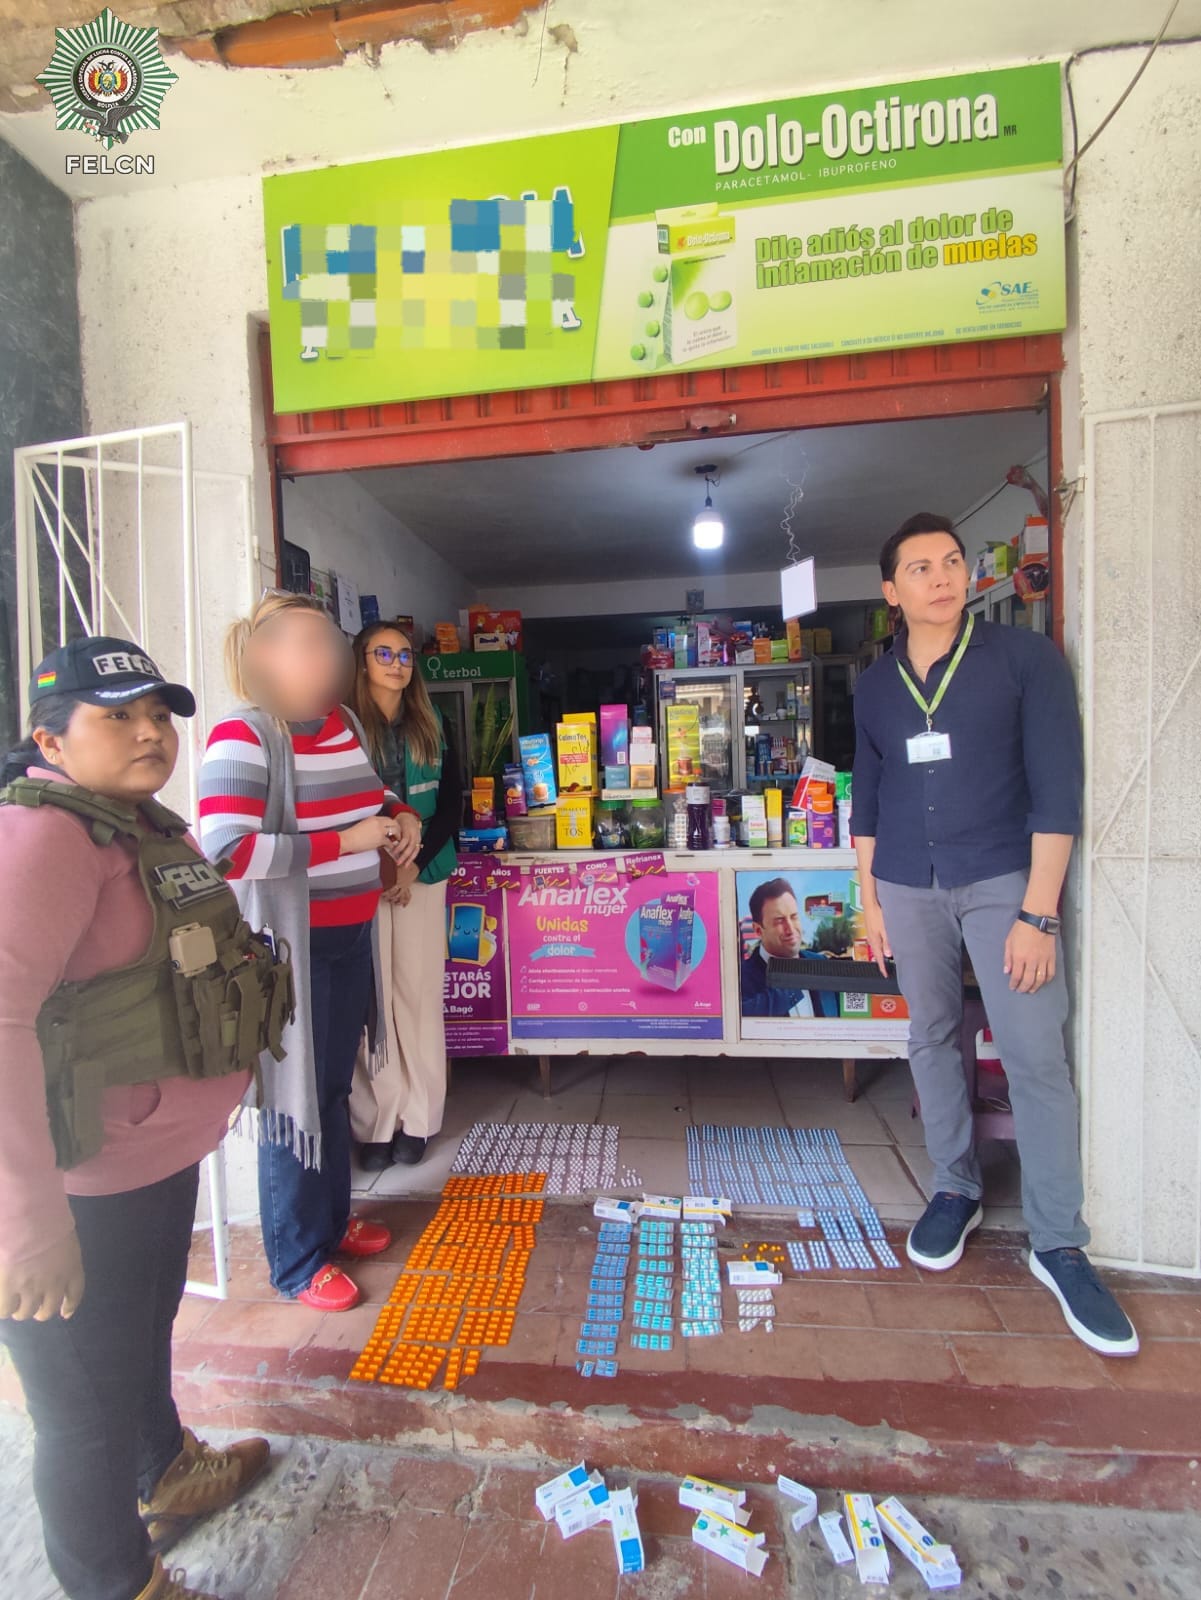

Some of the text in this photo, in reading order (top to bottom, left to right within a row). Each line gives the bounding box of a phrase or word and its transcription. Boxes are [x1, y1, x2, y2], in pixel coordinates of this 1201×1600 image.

[668, 93, 1017, 175] Con Dolo-Octirona MR
[819, 158, 897, 178] IBUPROFENO
[755, 207, 1013, 262] Dile adiós al dolor de
[756, 232, 1038, 289] Inflamación de muelas
[1000, 281, 1032, 296] SAE
[96, 656, 158, 675] FELC
[443, 666, 481, 678] terbol
[491, 868, 512, 877] AÑOS
[534, 866, 565, 875] FUERTES
[586, 862, 608, 871] COMO
[583, 904, 628, 917] mujer
[640, 905, 673, 920] Anaflex
[547, 944, 576, 956] dolor
[450, 1004, 473, 1014] Bagó
